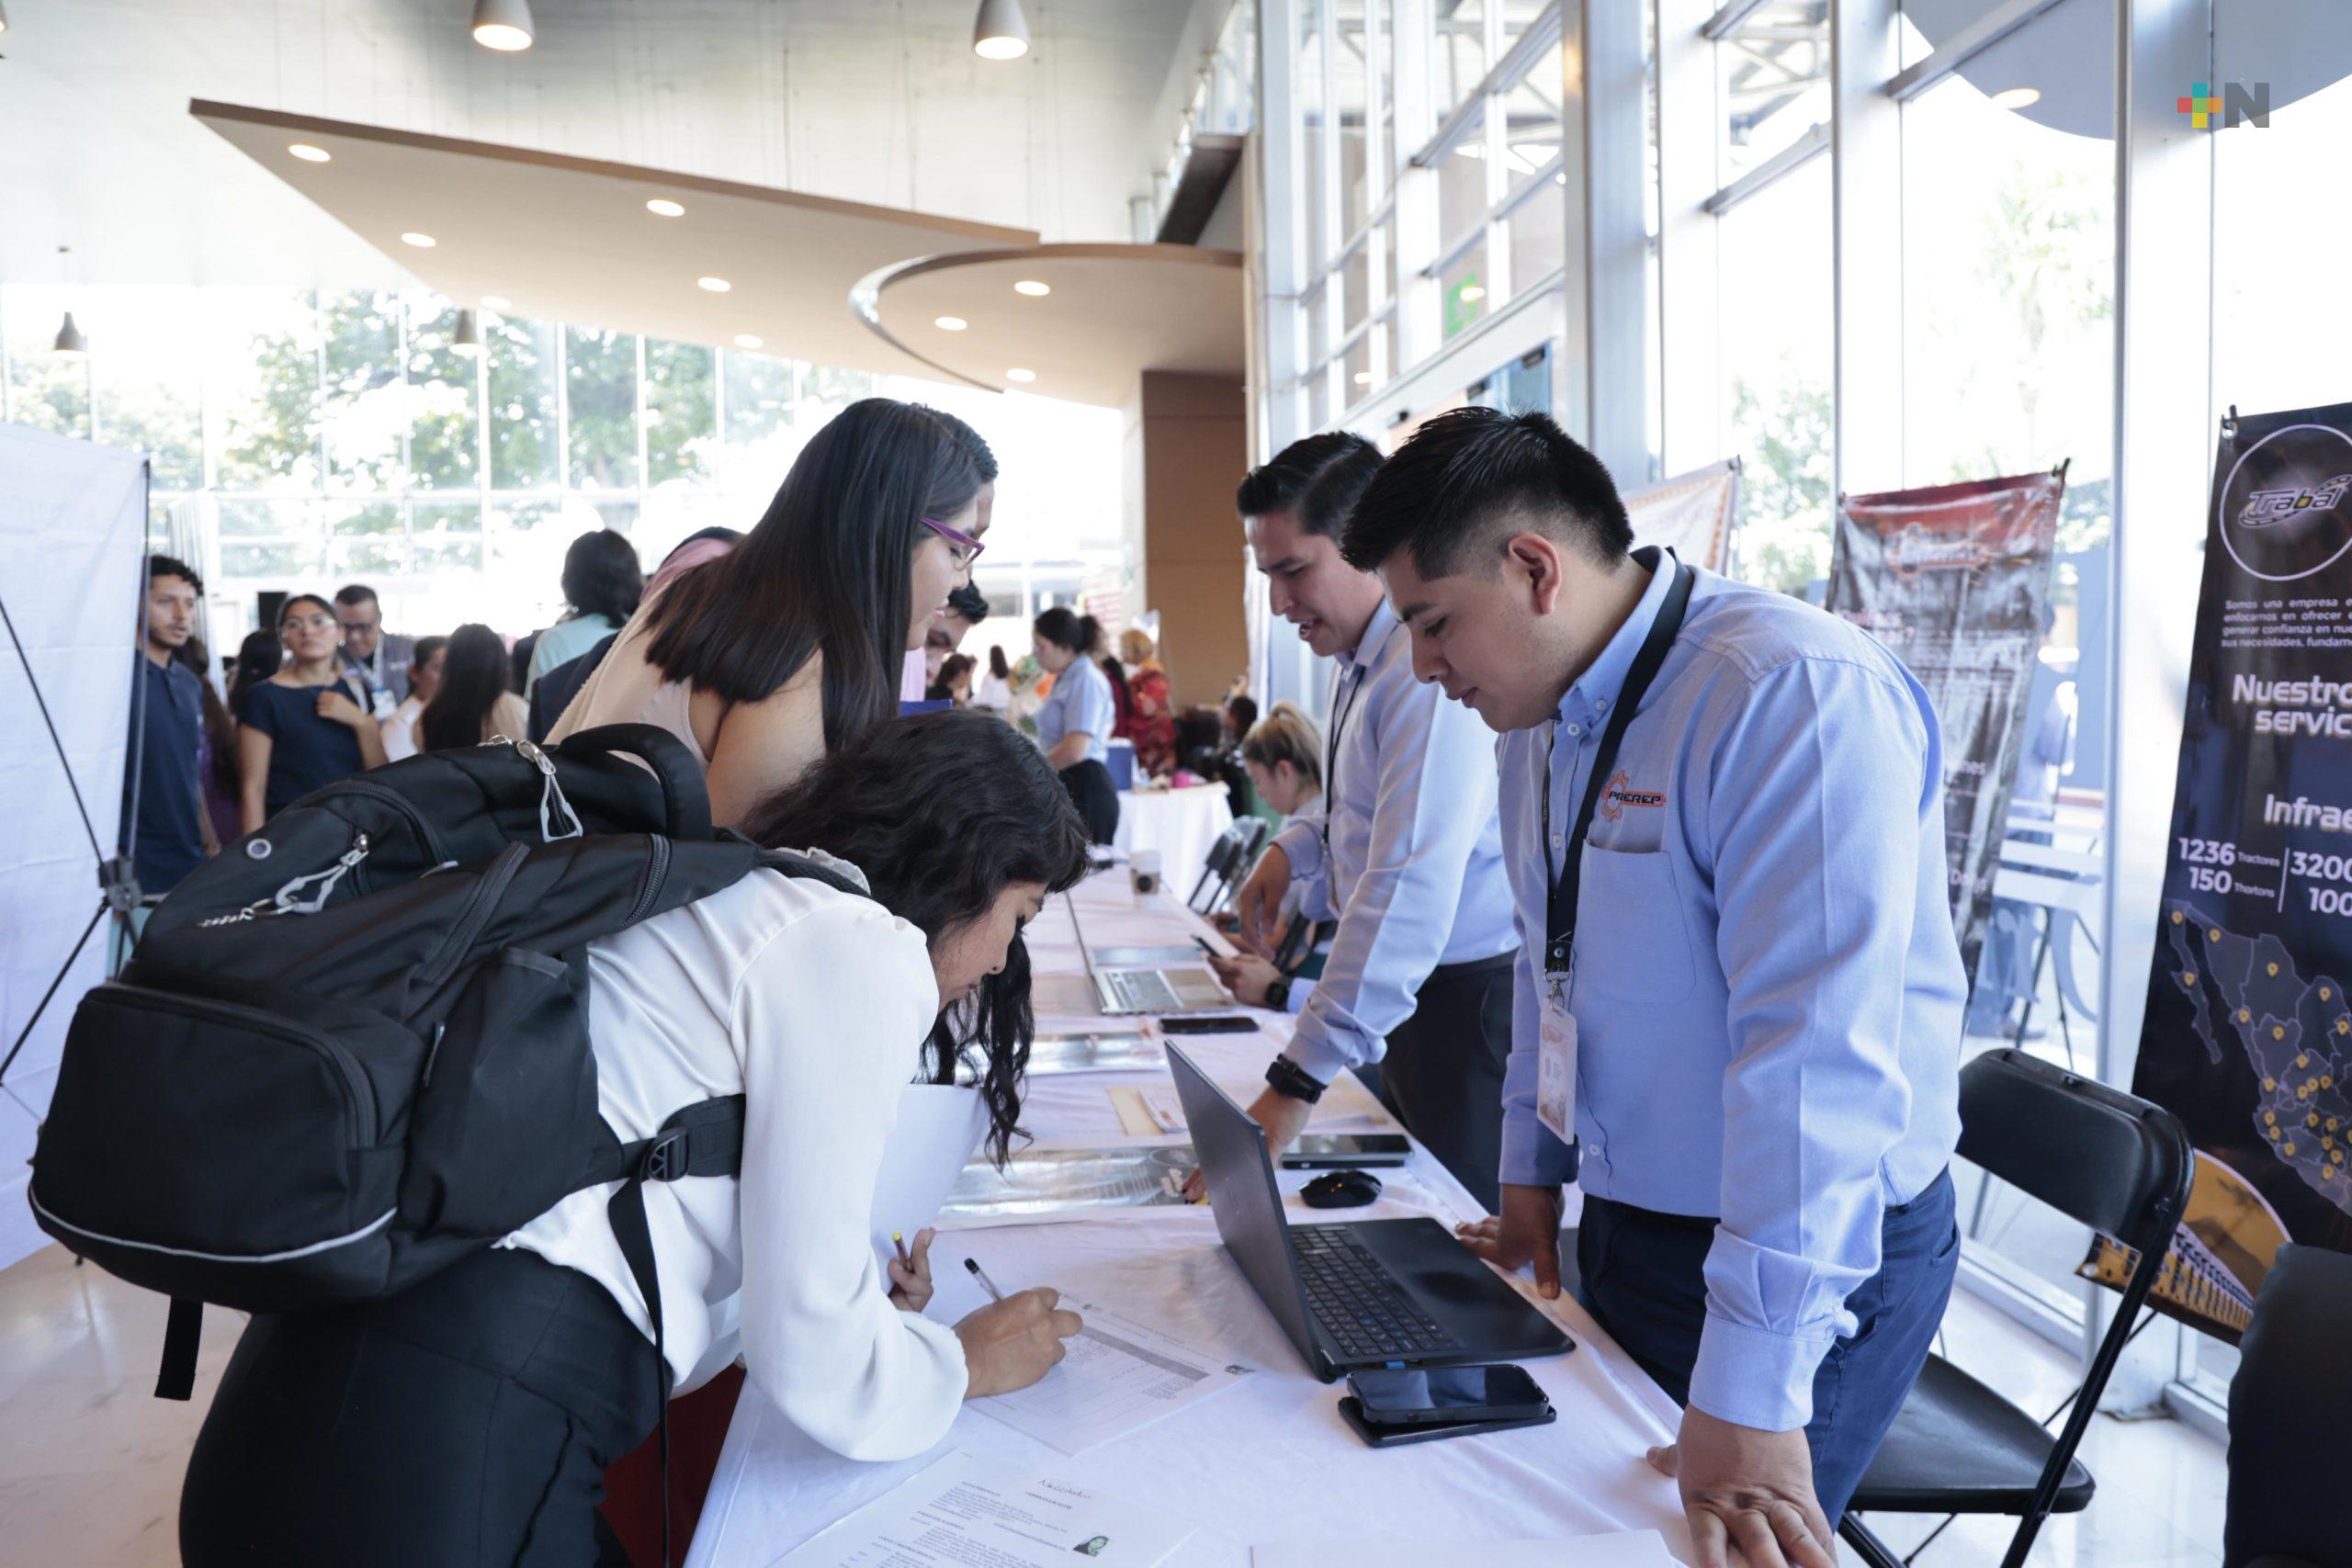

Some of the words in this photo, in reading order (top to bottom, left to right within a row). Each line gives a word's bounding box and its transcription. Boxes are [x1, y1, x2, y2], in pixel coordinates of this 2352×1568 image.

[2263, 600, 2283, 609] una
[2289, 599, 2338, 609] empresa
[2281, 613, 2296, 621] en
[2301, 610, 2342, 621] ofrecer
[2262, 624, 2312, 635] confianza
[2315, 626, 2330, 634] en
[2255, 705, 2352, 737] servic
[1608, 790, 1662, 806] PREREP
[2178, 837, 2236, 867] 1236
[2188, 866, 2233, 895] 150
[2308, 886, 2352, 918] 100
